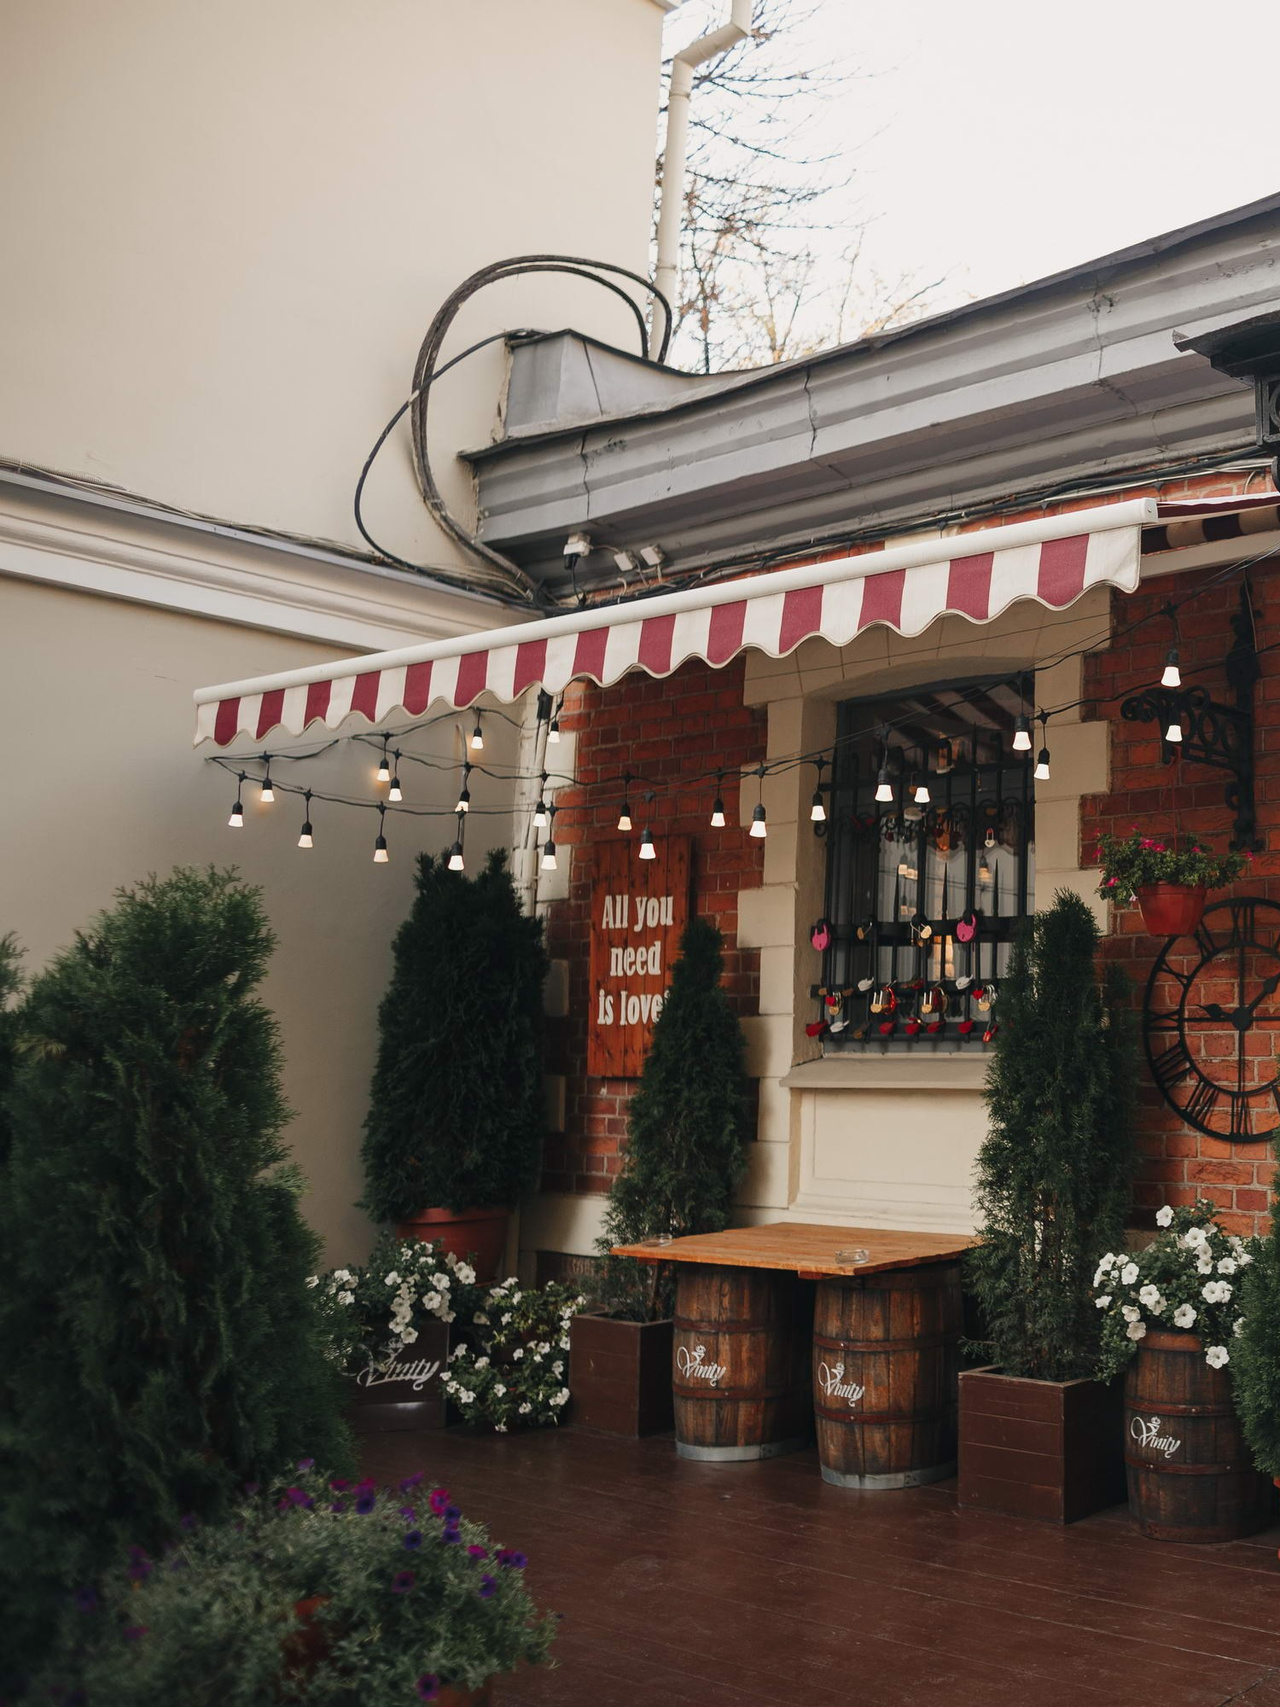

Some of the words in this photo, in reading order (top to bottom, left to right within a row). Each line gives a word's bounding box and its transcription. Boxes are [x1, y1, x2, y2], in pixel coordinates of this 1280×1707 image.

[601, 894, 629, 930] All
[633, 896, 674, 933] you
[609, 940, 662, 977] need
[597, 988, 614, 1025] is
[619, 989, 670, 1026] love
[676, 1344, 727, 1387] Vinity
[817, 1361, 866, 1408] Vinity
[1130, 1416, 1182, 1459] Vinity
